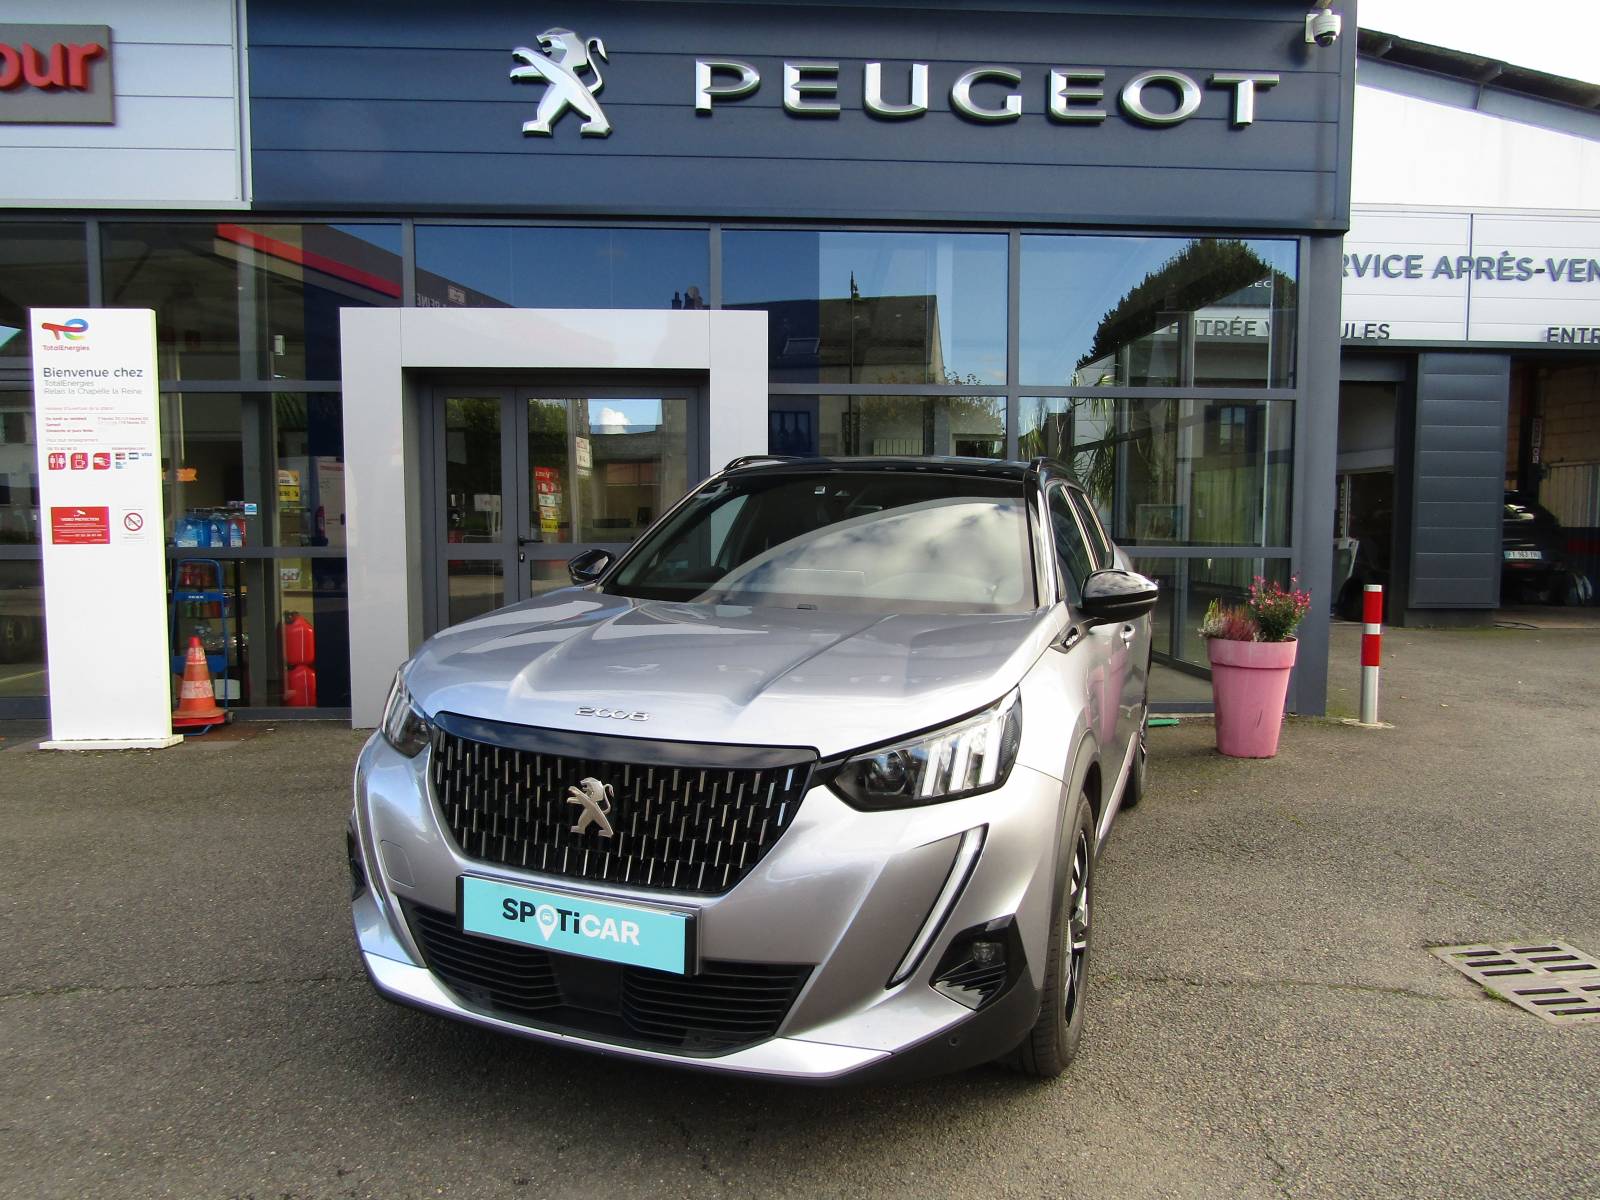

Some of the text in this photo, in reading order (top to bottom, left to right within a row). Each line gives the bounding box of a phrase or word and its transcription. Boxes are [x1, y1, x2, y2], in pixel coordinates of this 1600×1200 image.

[694, 57, 1281, 128] PEUGEOT
[42, 344, 90, 352] TotalEnergies
[43, 367, 144, 378] Bienvenue chez
[575, 706, 649, 722] 2008
